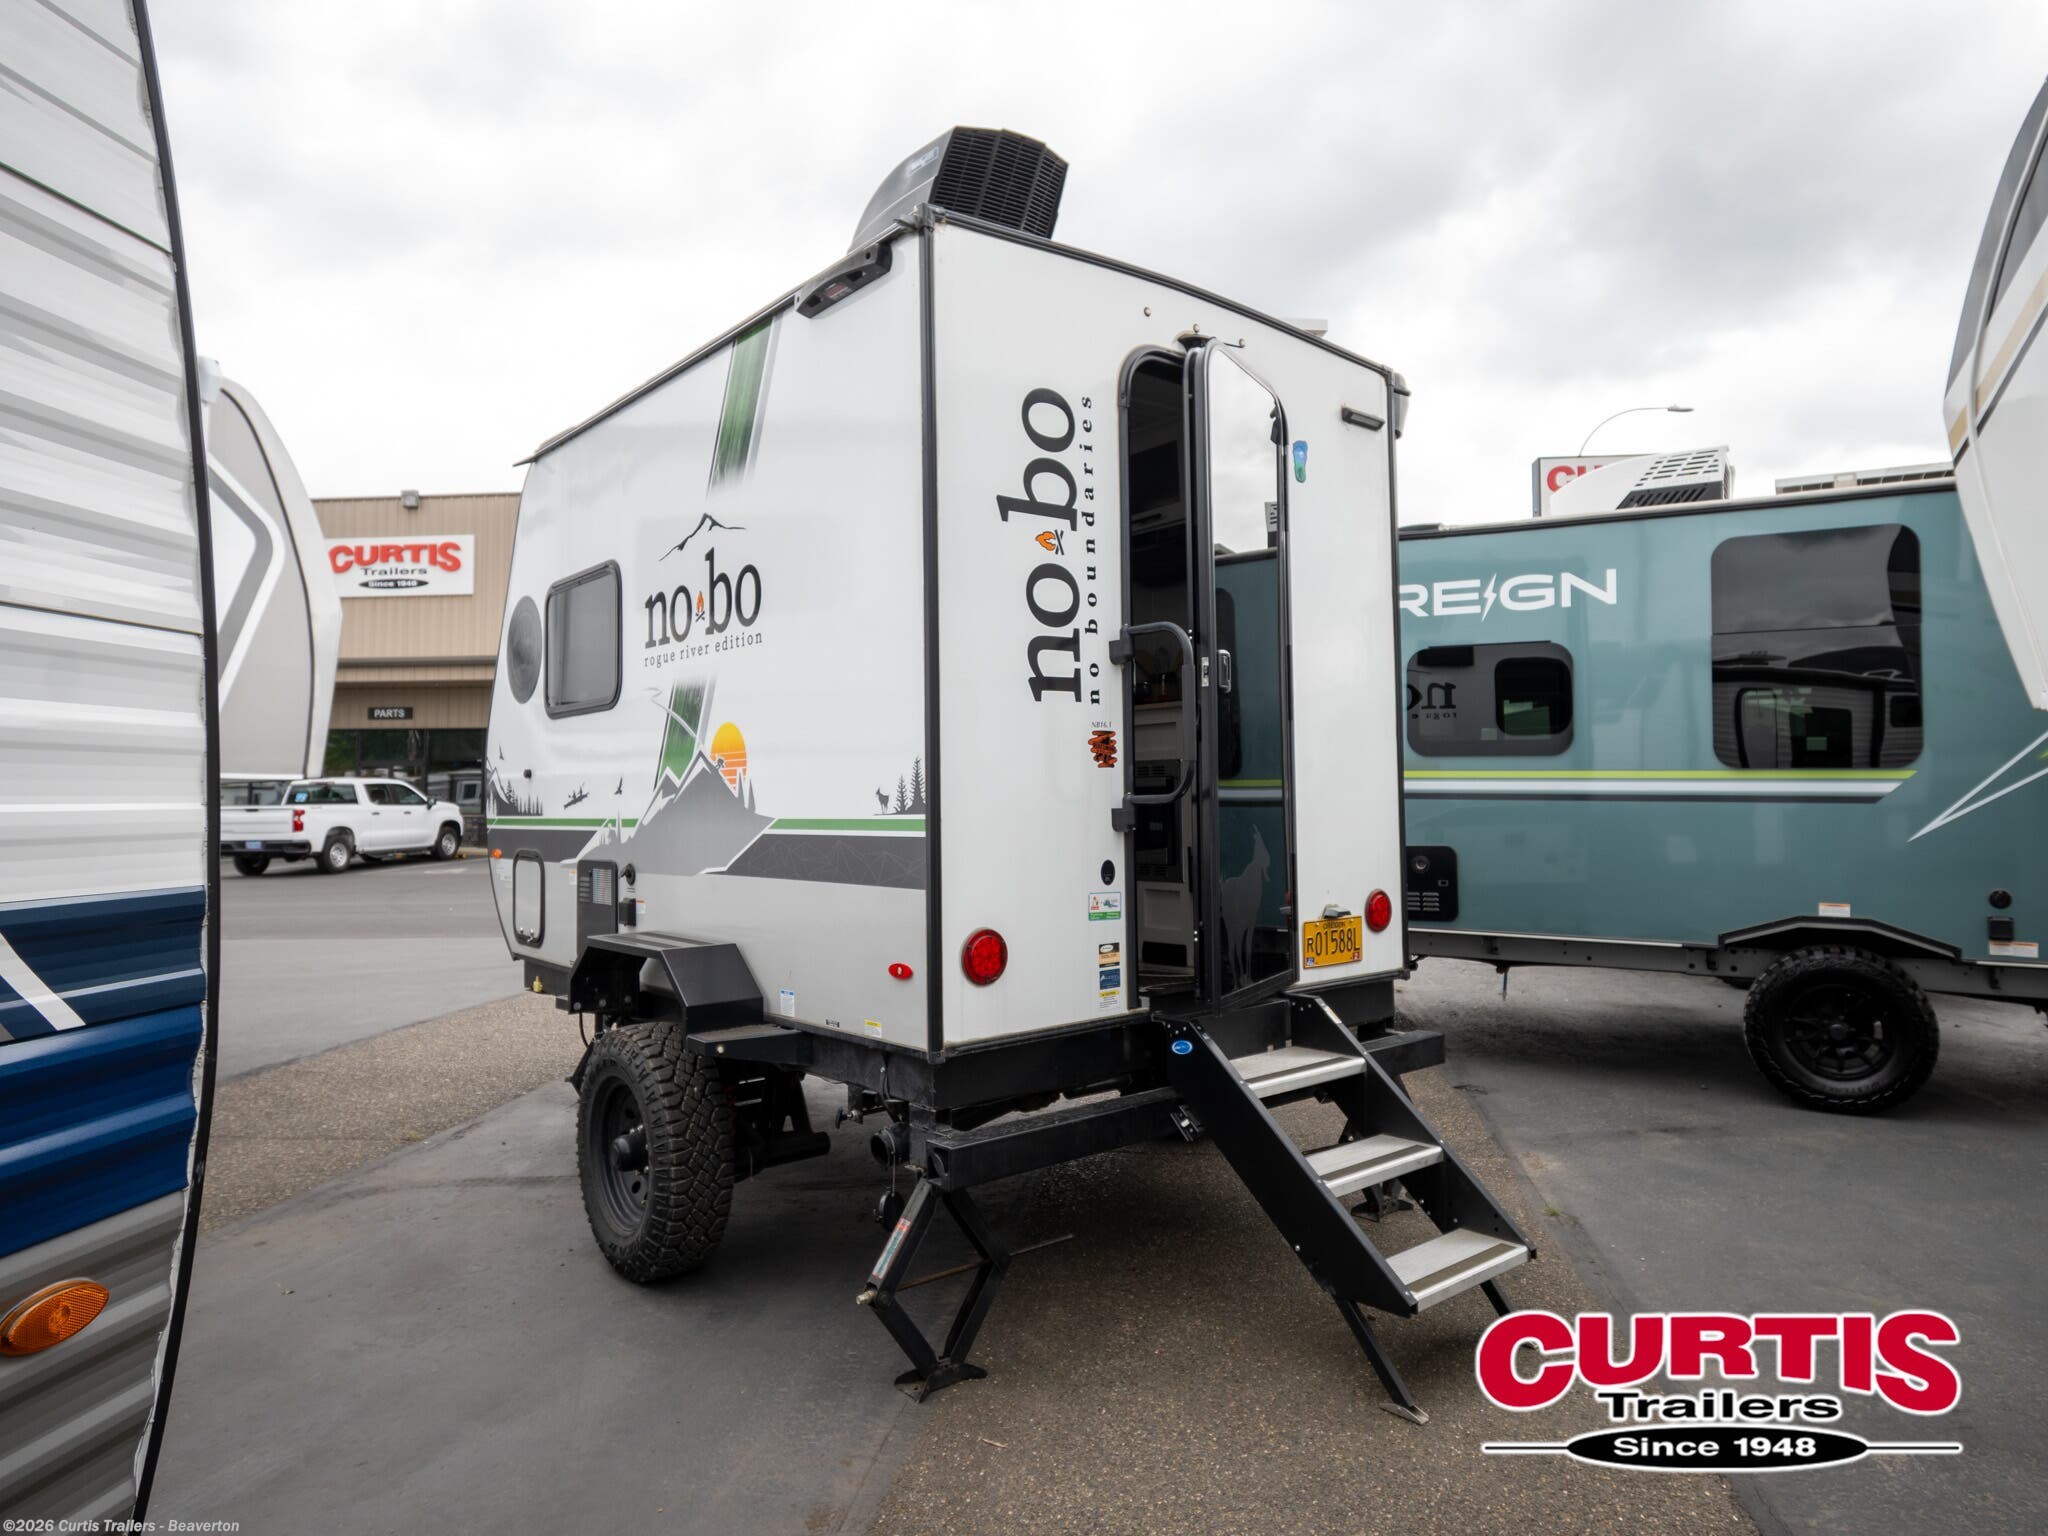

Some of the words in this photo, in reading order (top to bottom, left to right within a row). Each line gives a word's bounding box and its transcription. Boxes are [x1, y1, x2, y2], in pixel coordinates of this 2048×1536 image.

[1079, 396, 1099, 635] boundaries
[328, 542, 461, 574] CURTIS
[360, 567, 427, 576] Trailers
[368, 579, 395, 588] Since
[397, 579, 418, 587] 1948
[644, 651, 675, 668] rogue
[680, 645, 710, 659] river
[715, 632, 763, 652] edition
[1089, 662, 1100, 705] no
[374, 708, 405, 718] PARTS
